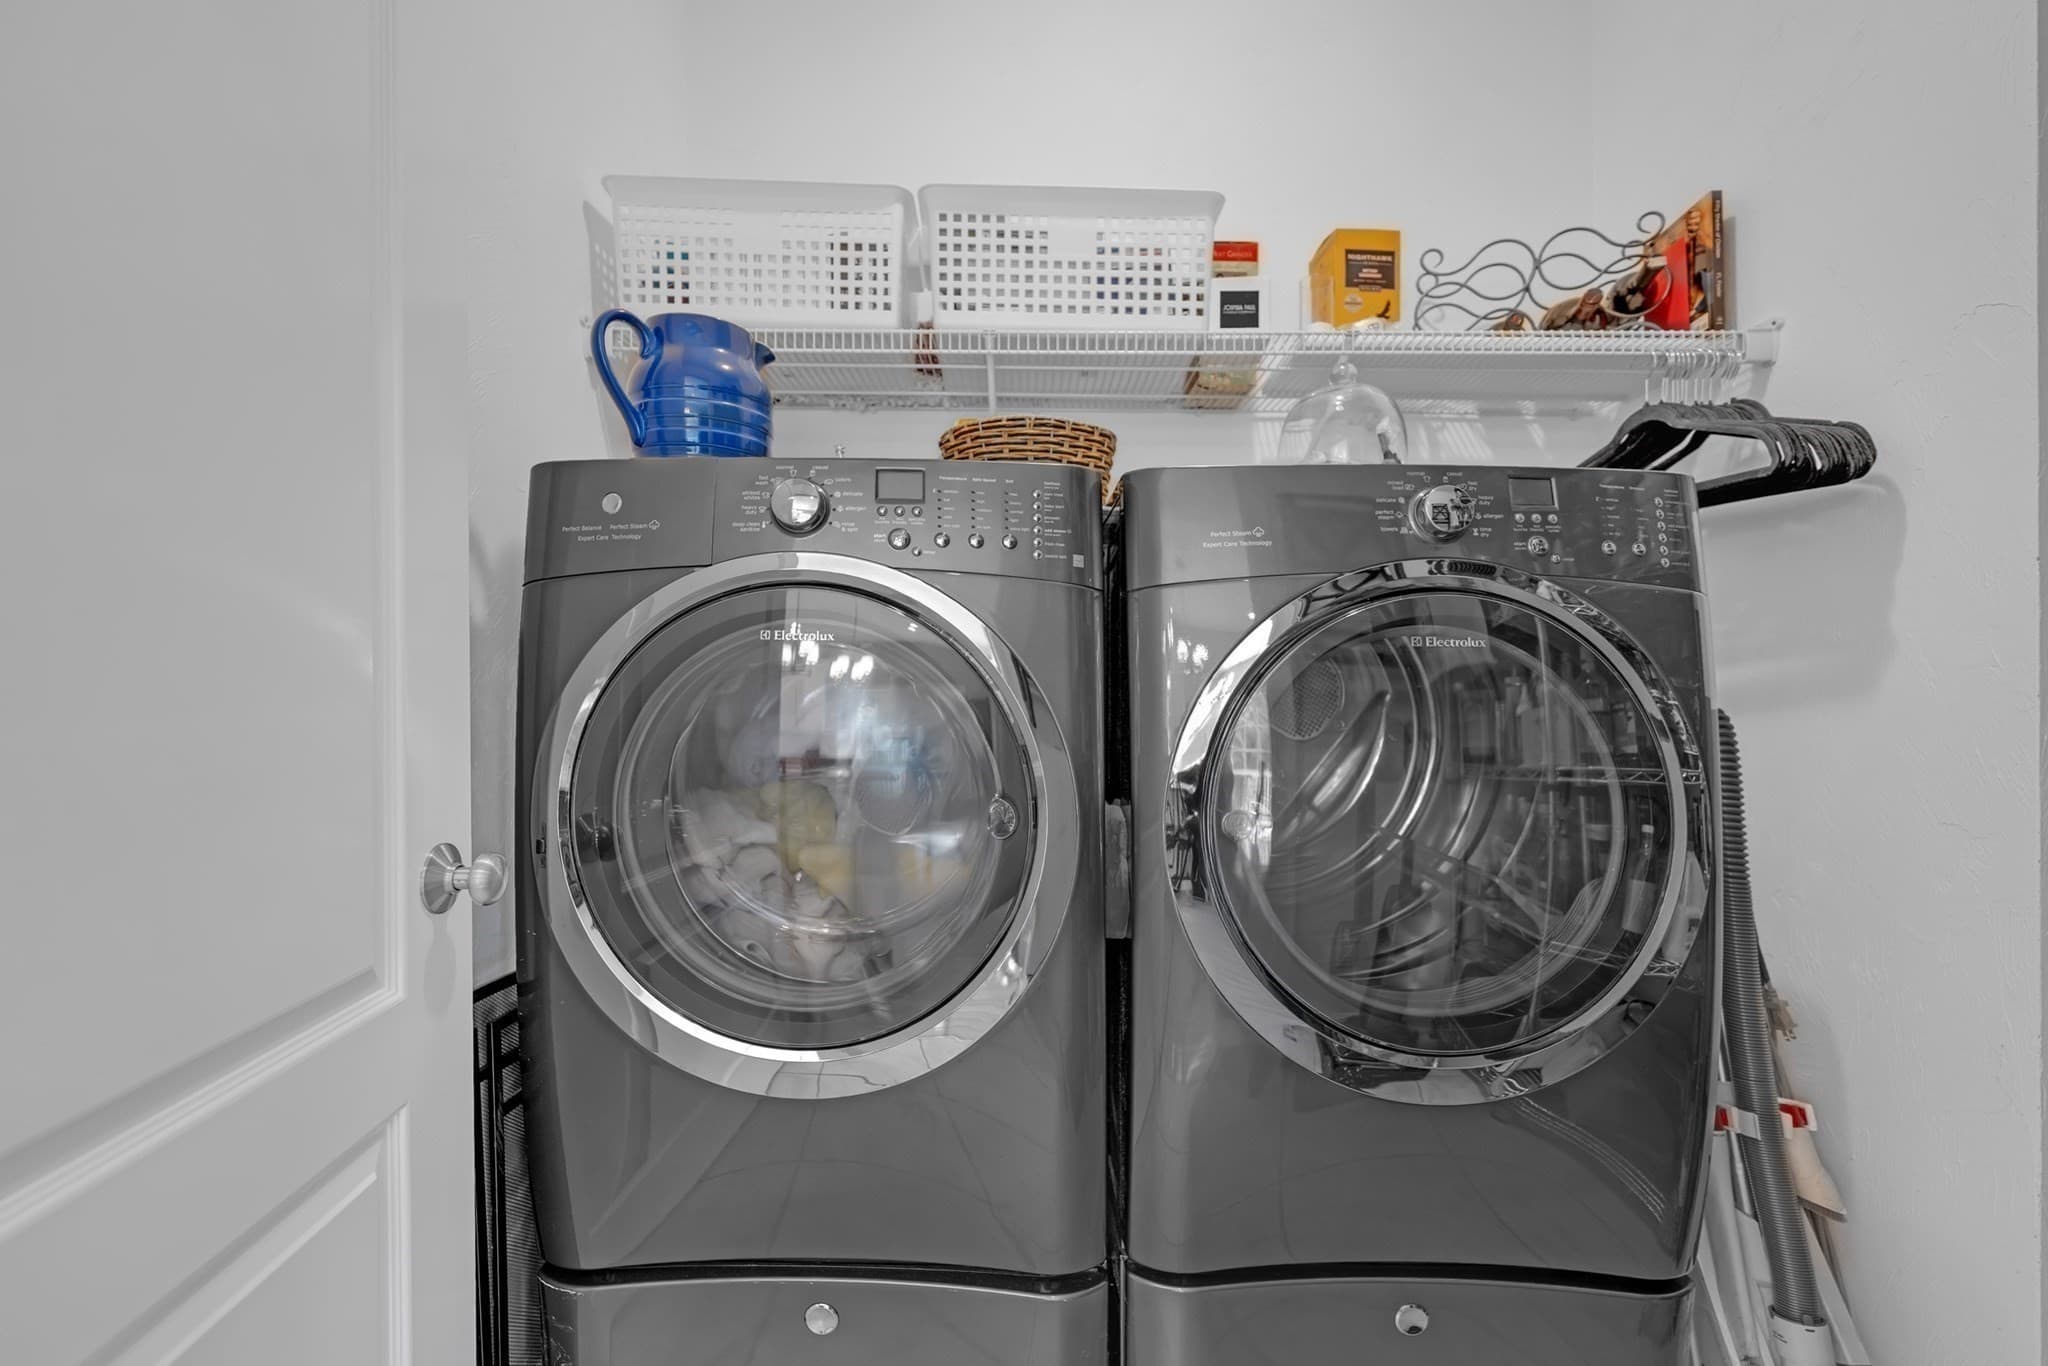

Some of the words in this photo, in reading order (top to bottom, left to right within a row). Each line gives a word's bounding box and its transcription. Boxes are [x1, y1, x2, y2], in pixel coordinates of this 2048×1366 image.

[1347, 254, 1393, 262] NIGHTHAWK
[774, 630, 835, 641] Electrolux
[1425, 636, 1487, 648] Electrolux
